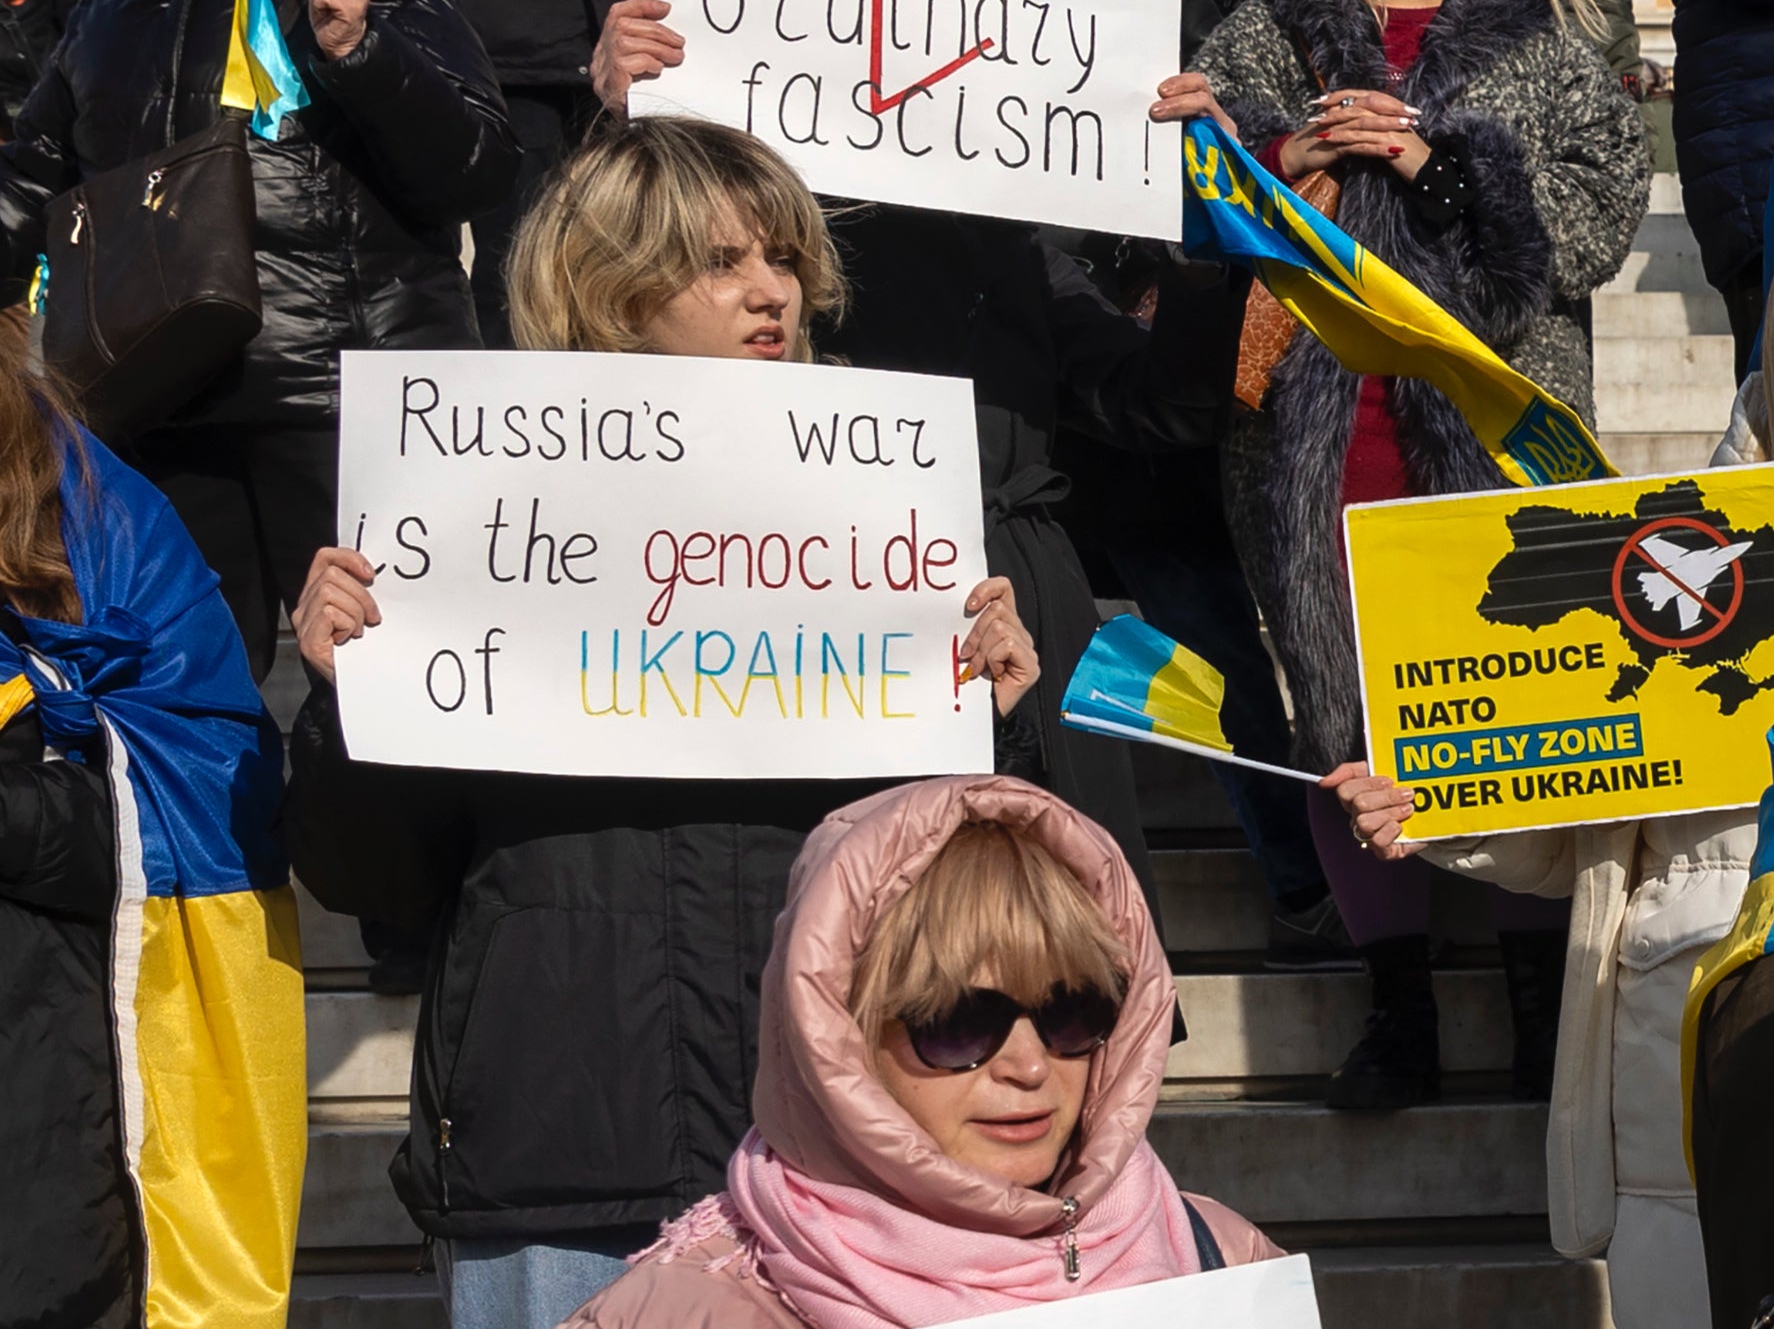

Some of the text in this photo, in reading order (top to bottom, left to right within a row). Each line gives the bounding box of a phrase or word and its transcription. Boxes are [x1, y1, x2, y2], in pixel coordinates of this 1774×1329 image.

[400, 374, 937, 469] Russia's war
[353, 497, 959, 627] is the genocide
[425, 627, 507, 717] of
[1394, 643, 1606, 690] INTRODUCE
[1398, 696, 1497, 731] NATO
[1402, 723, 1637, 773] NO-FLY ZONE
[1412, 759, 1685, 814] OVER UKRAINE!
